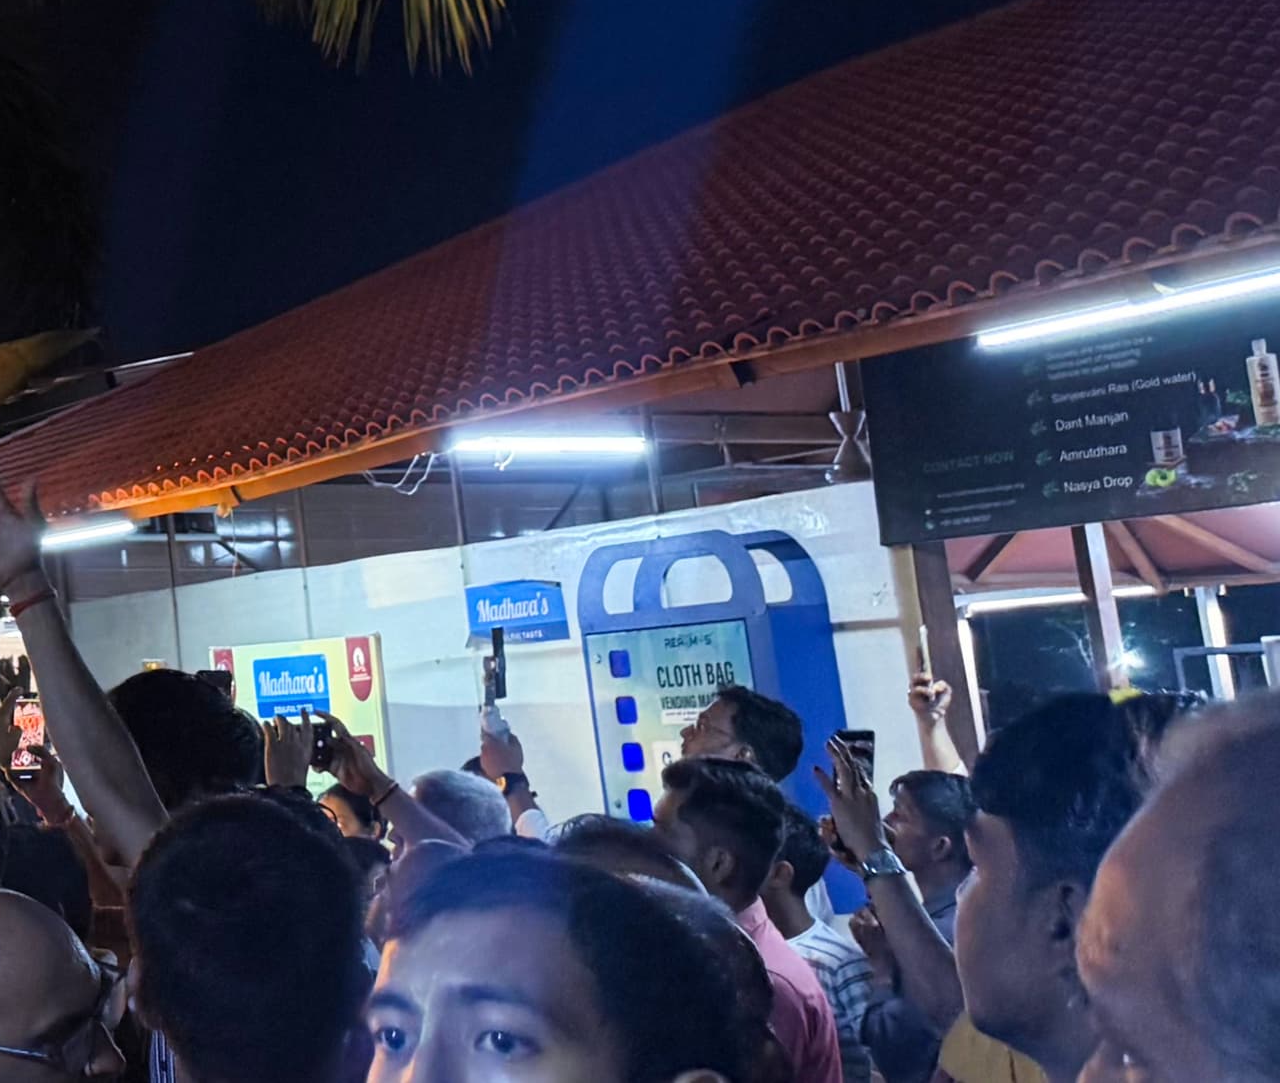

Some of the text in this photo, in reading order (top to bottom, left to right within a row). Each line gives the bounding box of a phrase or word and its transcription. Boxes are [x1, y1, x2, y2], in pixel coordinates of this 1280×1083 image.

[1108, 382, 1130, 395] Ras
[1131, 378, 1161, 391] (Gold
[1162, 370, 1197, 386] water)
[1055, 411, 1129, 432] Dant Manjan
[1059, 443, 1128, 462] Amrutdhara
[1063, 474, 1134, 494] Nasya Drop
[476, 591, 549, 623] Madhava's
[258, 666, 325, 697] Madhava's
[656, 661, 735, 688] CLOTH BAG
